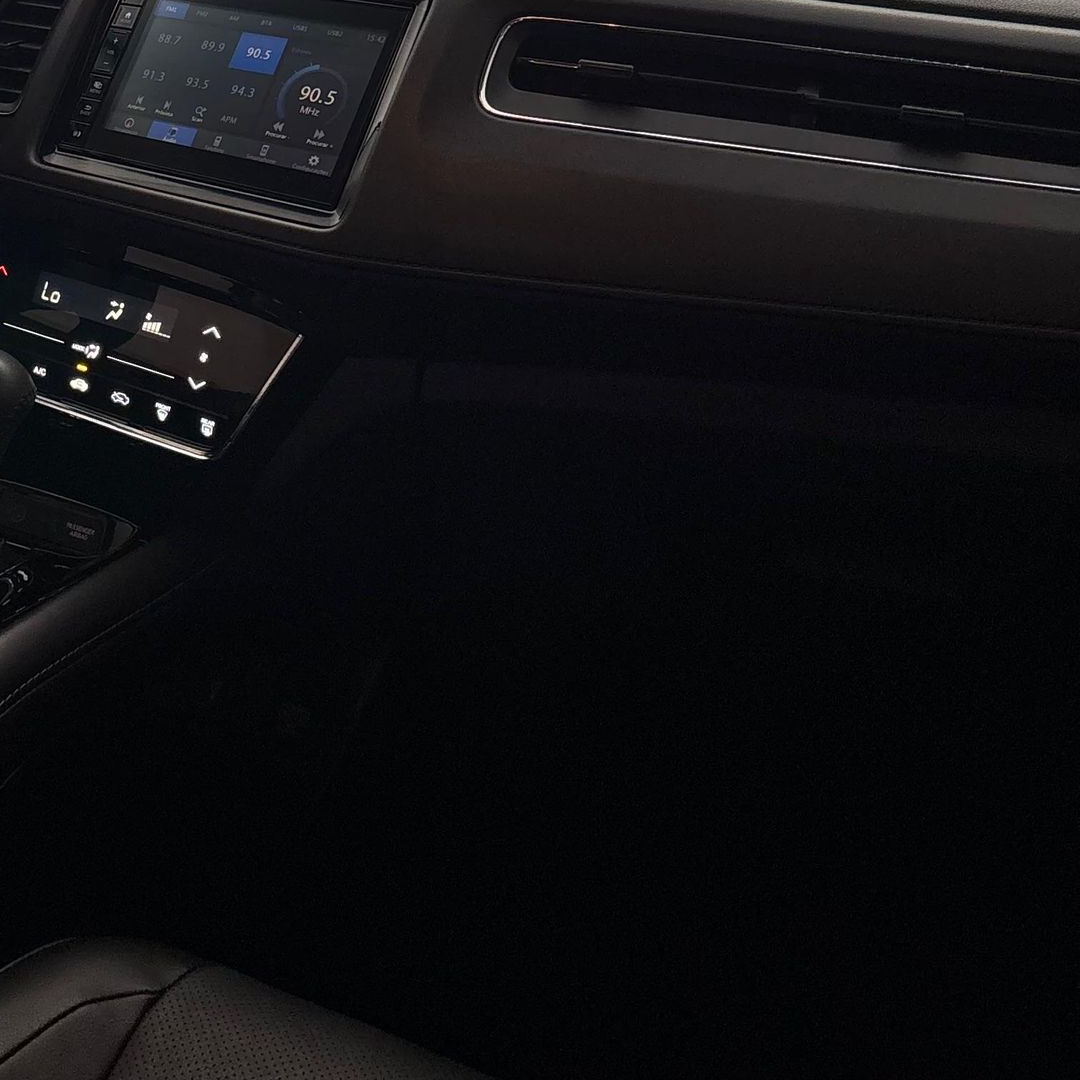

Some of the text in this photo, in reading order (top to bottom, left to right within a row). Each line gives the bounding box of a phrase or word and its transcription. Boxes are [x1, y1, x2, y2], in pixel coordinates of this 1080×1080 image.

[158, 33, 272, 61] 88.7 89.9 90.5
[142, 68, 256, 98] 91.3 93.5 94.3
[298, 85, 338, 106] 90.5
[299, 105, 321, 117] MHz
[33, 366, 47, 377] A/C
